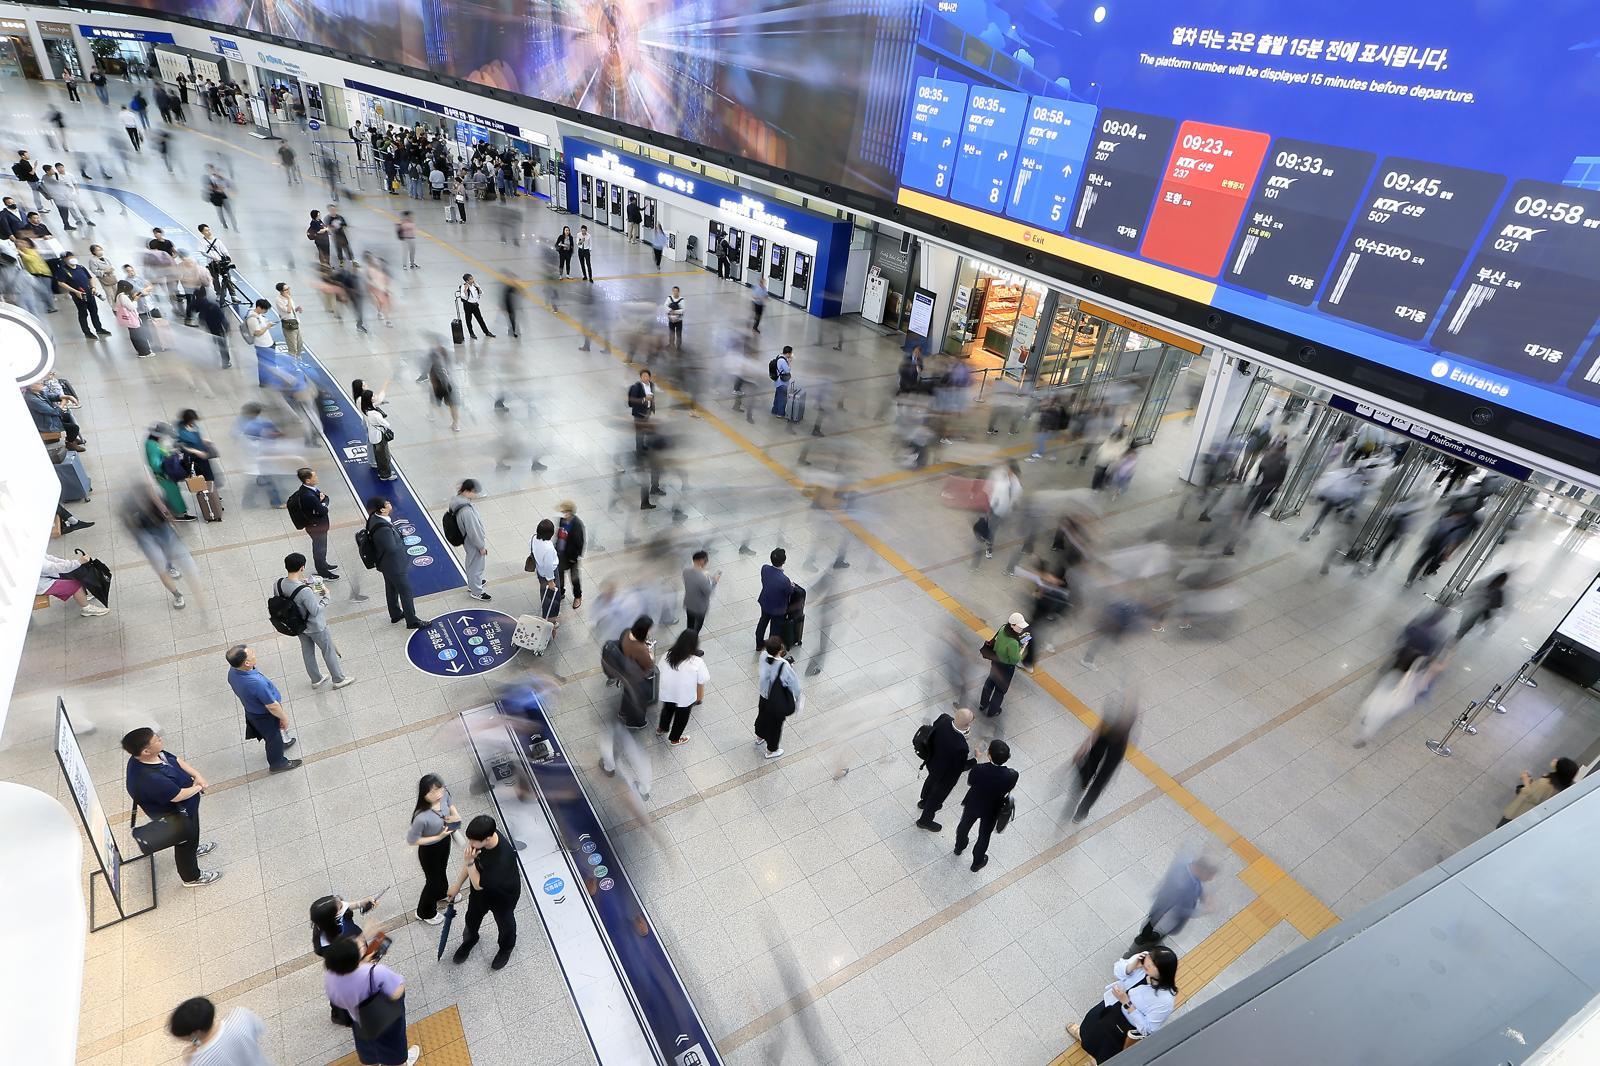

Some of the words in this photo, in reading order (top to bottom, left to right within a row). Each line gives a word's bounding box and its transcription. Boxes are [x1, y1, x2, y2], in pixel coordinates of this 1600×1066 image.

[1172, 27, 1197, 46] 열차
[1199, 29, 1225, 49] 타는
[1227, 32, 1255, 52] 곳은
[1257, 34, 1287, 55] 출발
[1290, 39, 1324, 59] 15분
[1326, 41, 1360, 62] 전에
[1358, 44, 1447, 71] 표시됩니다.
[1140, 54, 1154, 65] The
[1155, 56, 1191, 69] platform
[1192, 61, 1227, 74] number
[1229, 65, 1244, 76] will
[1246, 66, 1258, 78] be
[1260, 69, 1309, 84] displayed
[1311, 74, 1323, 85] 15
[1324, 76, 1368, 90] minutes
[1369, 80, 1408, 95] before
[1410, 85, 1474, 103] departure.
[919, 86, 942, 100] 08:35
[973, 96, 999, 112] 08:35
[1034, 107, 1063, 123] 08:58
[1029, 127, 1048, 137] KTX
[1103, 120, 1137, 138] 09:04
[1098, 141, 1120, 152] KTX
[1183, 135, 1222, 154] 09:23
[1022, 157, 1035, 169] 부산
[1095, 152, 1109, 160] 207
[1276, 152, 1322, 173] 09:33
[1176, 157, 1203, 168] KTX
[1198, 162, 1214, 172] 산천
[936, 173, 944, 187] 8
[1089, 174, 1103, 185] 마산
[1173, 169, 1189, 178] 237
[1267, 176, 1298, 189] KTX
[1384, 172, 1441, 196] 09:45
[990, 188, 999, 203] 8
[1164, 192, 1182, 204] 포항
[1264, 188, 1279, 199] 101
[1051, 205, 1062, 221] 5
[1373, 198, 1409, 212] KTX
[1402, 204, 1425, 217] 산천
[1515, 196, 1584, 224] 09:58
[1253, 213, 1273, 227] 부산
[1368, 211, 1390, 223] 507
[1117, 225, 1137, 238] 대기중
[1500, 224, 1546, 241] KTX
[1032, 235, 1044, 244] Exit
[1494, 239, 1519, 252] 021
[1355, 238, 1411, 261] 여수EXPO
[1412, 257, 1425, 265] 도착
[1288, 275, 1314, 289] 대기중
[1477, 267, 1506, 285] 부산
[1506, 280, 1521, 289] 도착
[1395, 306, 1427, 323] 대기중
[1524, 343, 1563, 363] 대기중
[1450, 368, 1509, 396] Entrance
[1431, 435, 1462, 451] Platforms
[481, 622, 492, 630] 곳
[485, 628, 495, 640] 타는
[490, 638, 504, 655] 지하철
